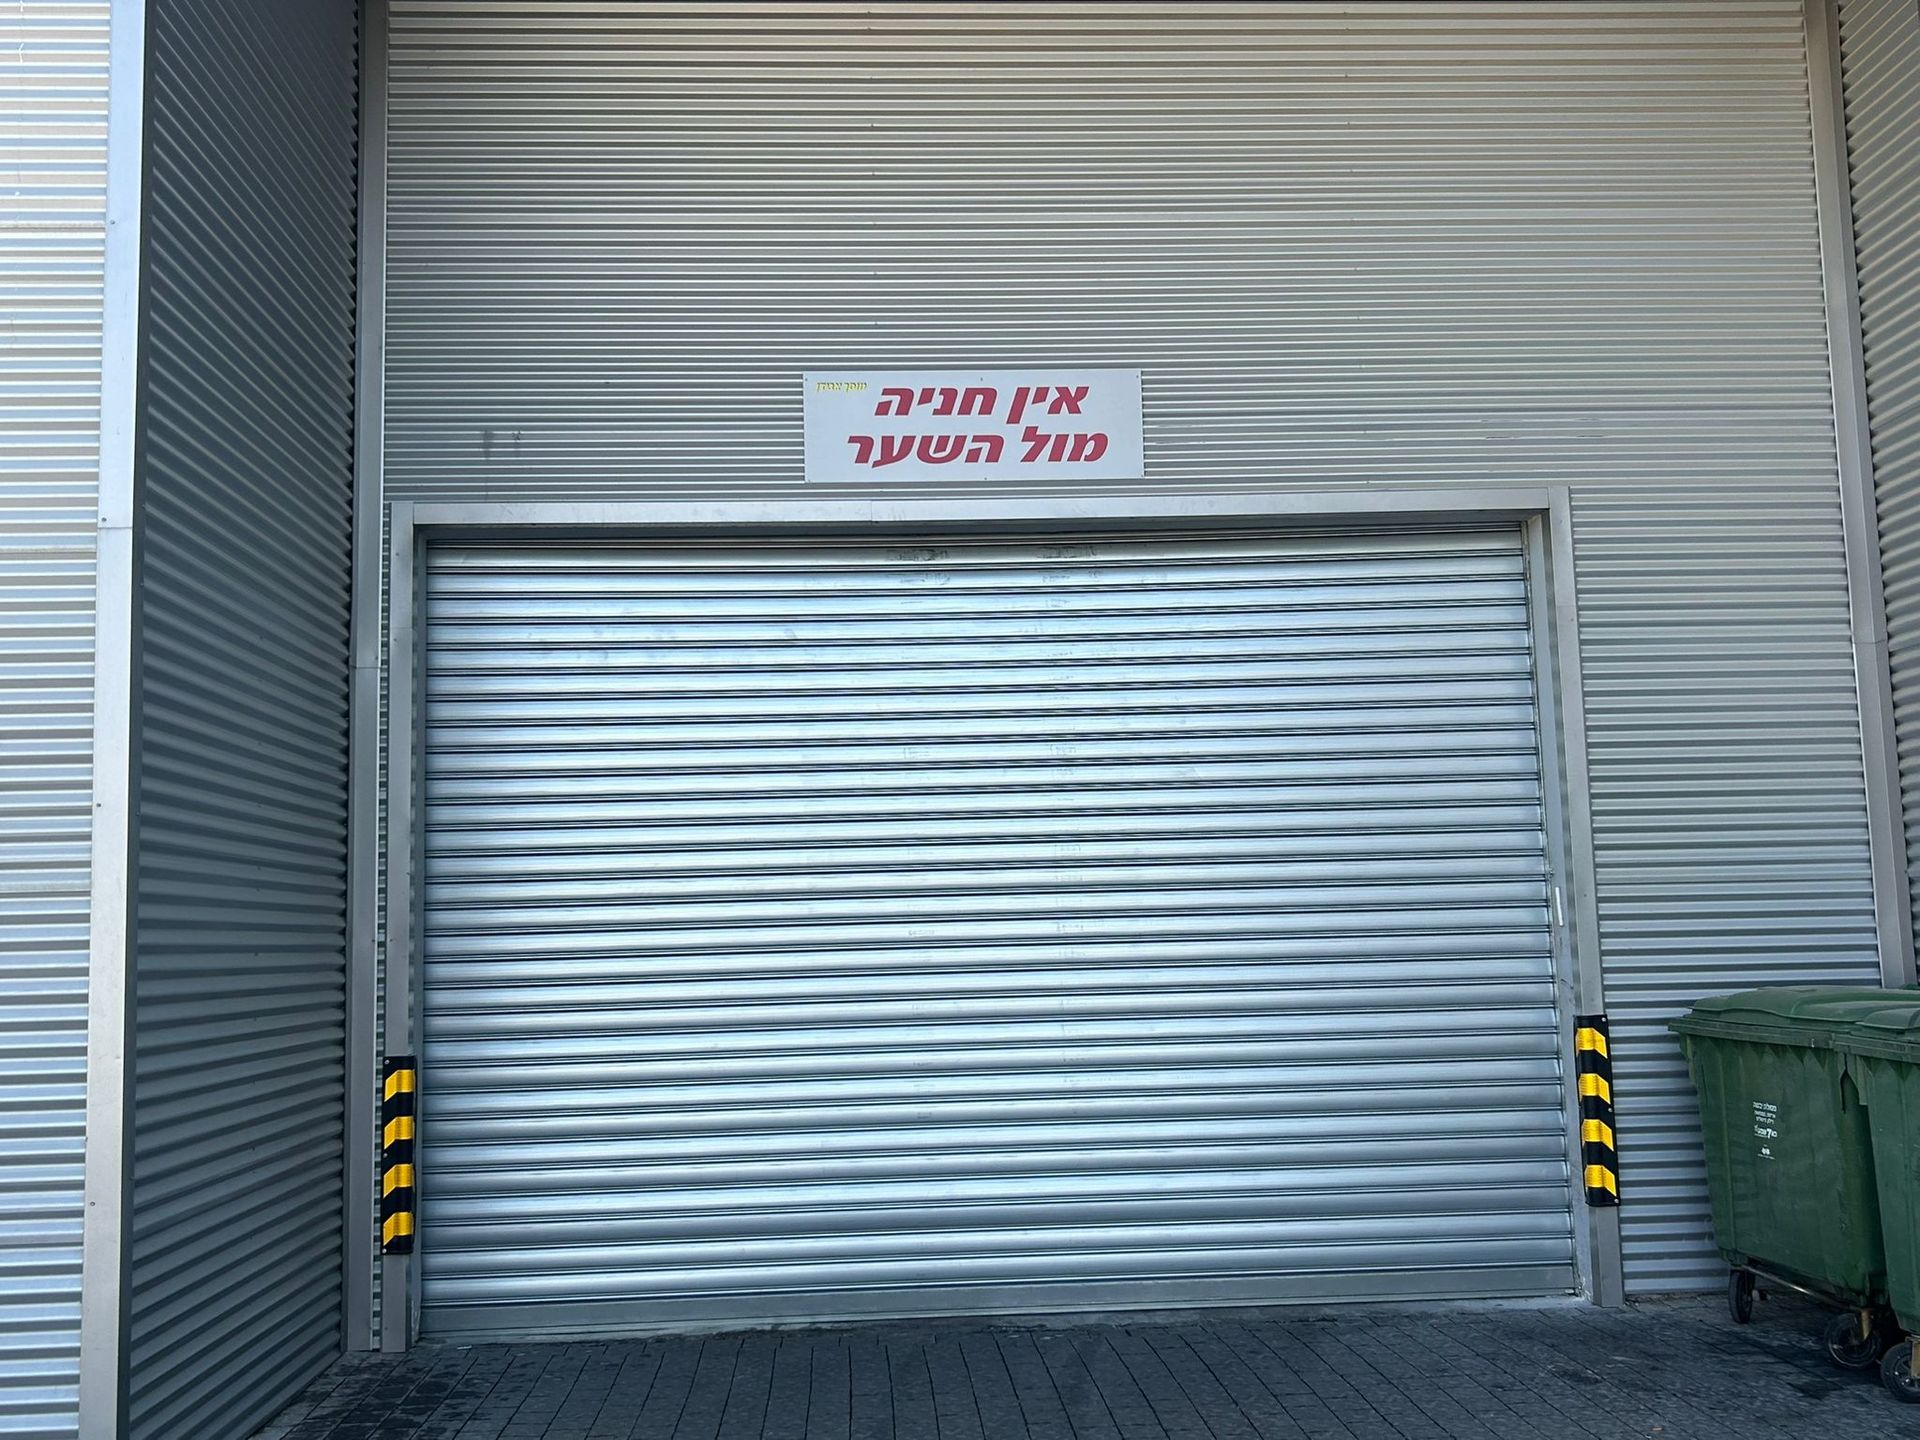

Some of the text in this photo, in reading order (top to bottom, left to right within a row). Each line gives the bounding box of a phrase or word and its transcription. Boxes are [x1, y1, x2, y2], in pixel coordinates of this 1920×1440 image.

[874, 386, 1089, 425] אין חניה
[847, 426, 1109, 469] מול השער
